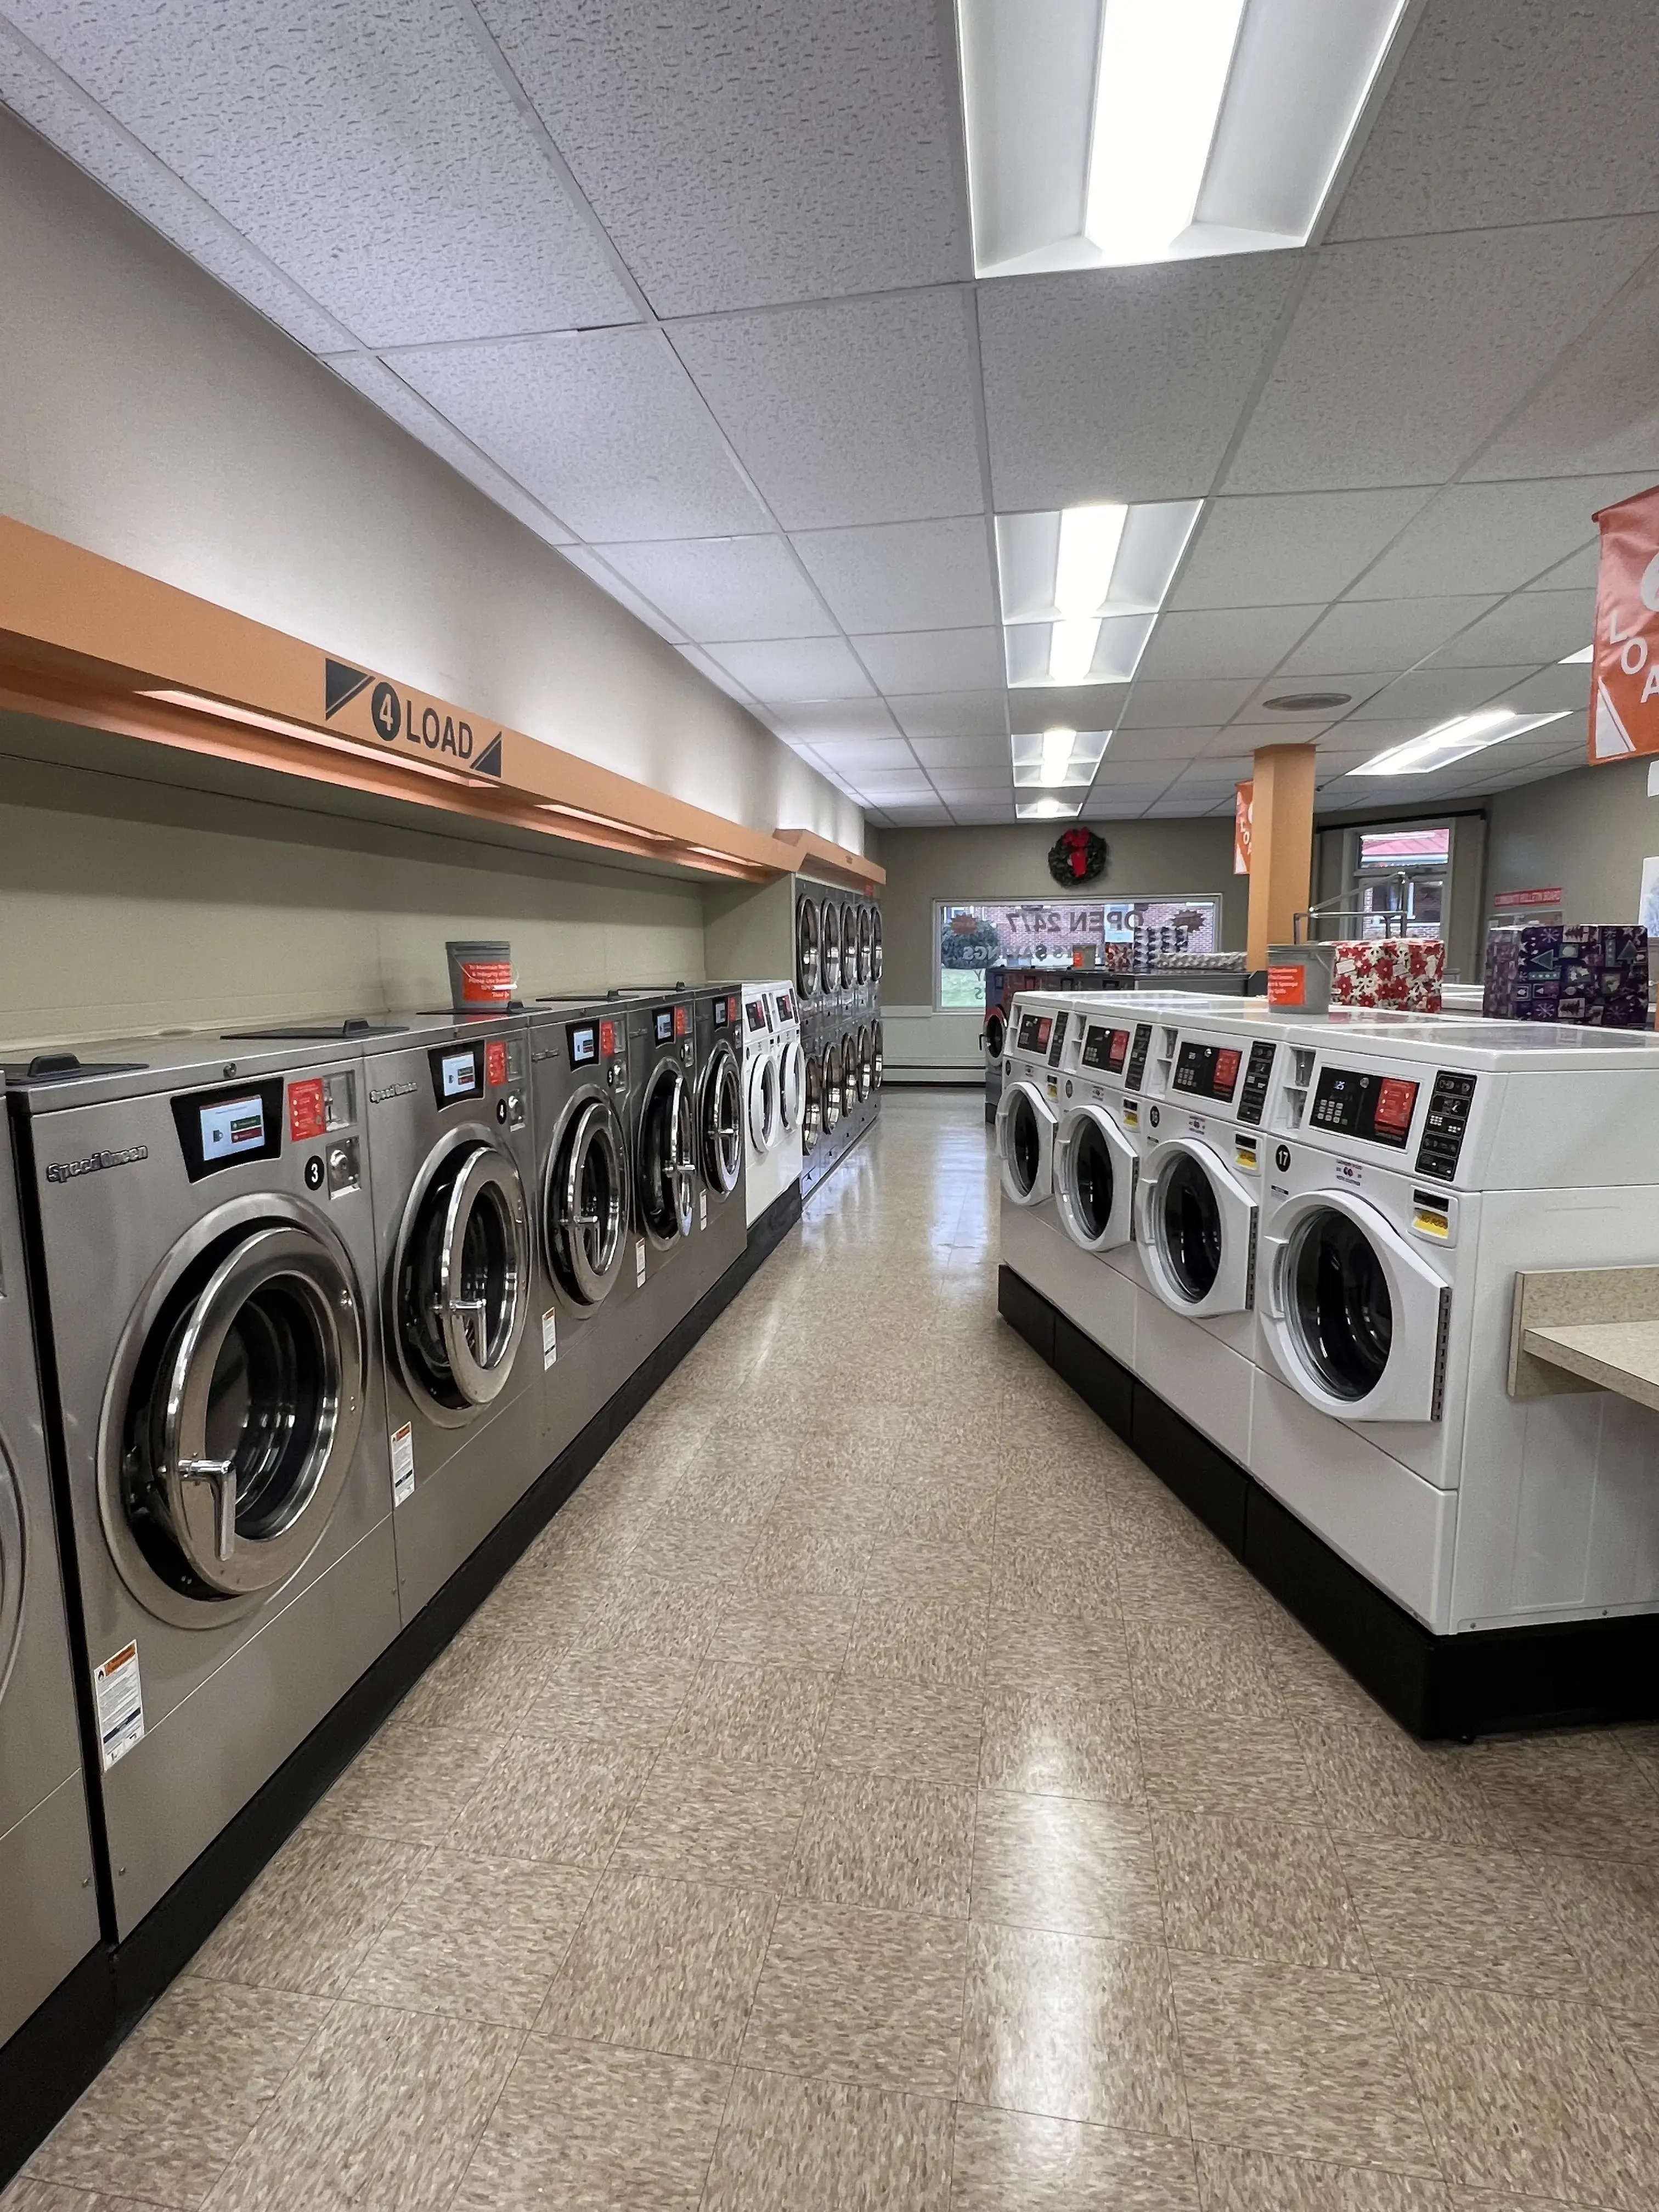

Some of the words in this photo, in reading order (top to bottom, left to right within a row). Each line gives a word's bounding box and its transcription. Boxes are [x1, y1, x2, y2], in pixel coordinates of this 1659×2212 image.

[379, 693, 394, 731] 4
[407, 699, 473, 759] LOAD
[46, 1153, 100, 1183] Speed
[100, 1145, 148, 1169] Queen
[1278, 1150, 1288, 1166] 17
[311, 1163, 318, 1183] 3
